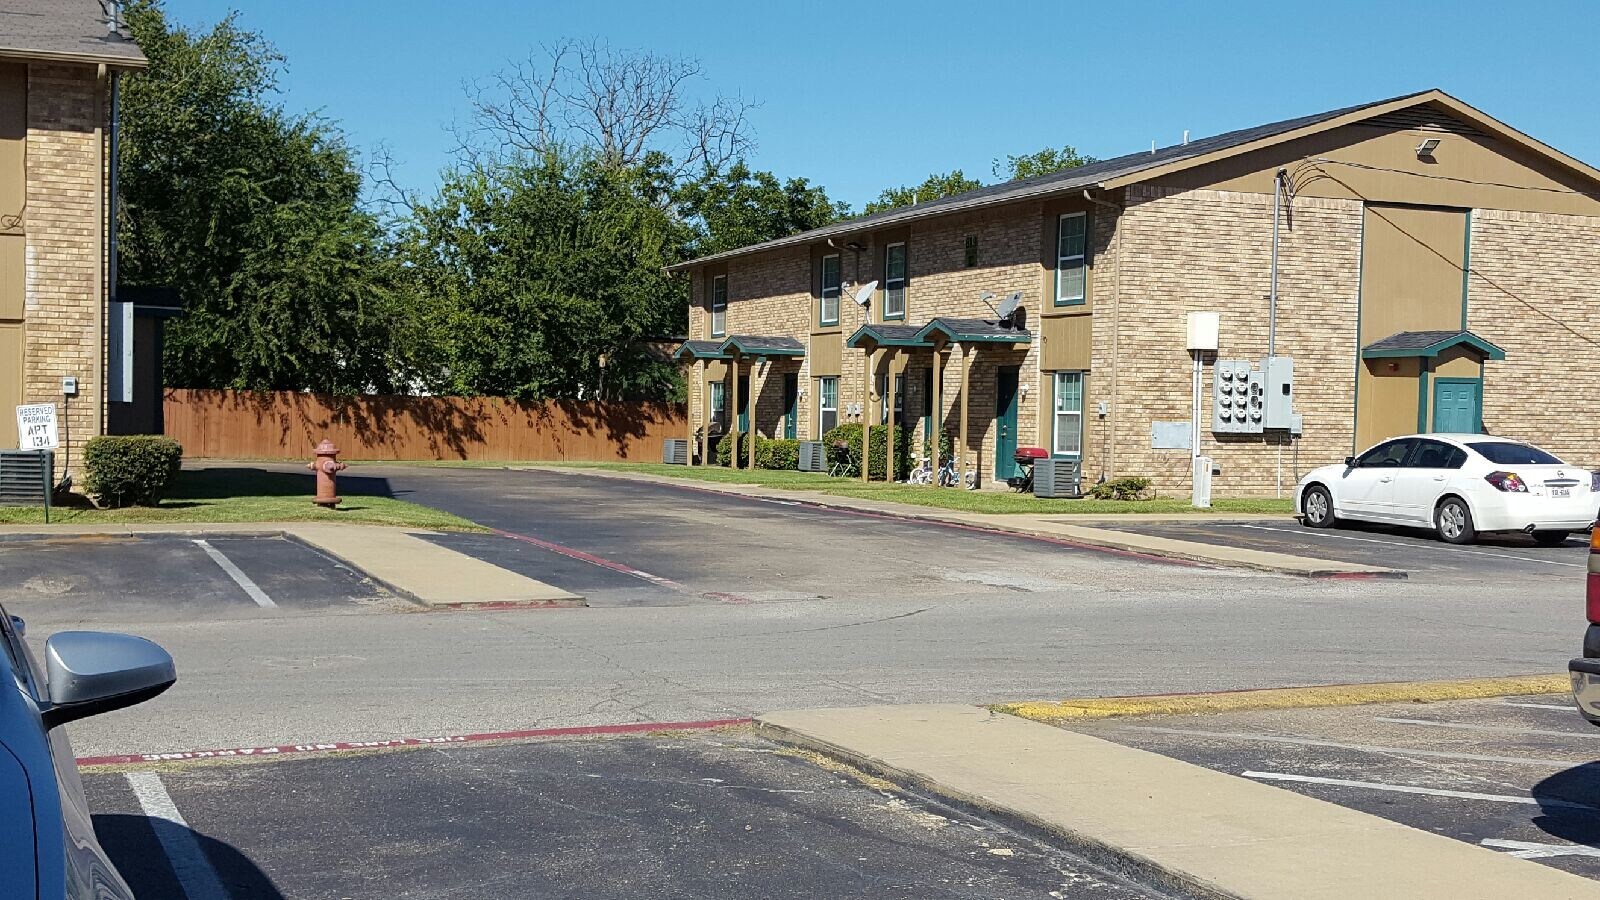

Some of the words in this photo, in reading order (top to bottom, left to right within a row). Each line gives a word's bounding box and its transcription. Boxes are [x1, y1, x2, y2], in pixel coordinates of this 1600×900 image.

[20, 407, 52, 416] RESERVED
[23, 415, 50, 423] PARKING
[28, 425, 47, 436] APT
[33, 436, 50, 446] 134
[141, 747, 279, 760] PARKING
